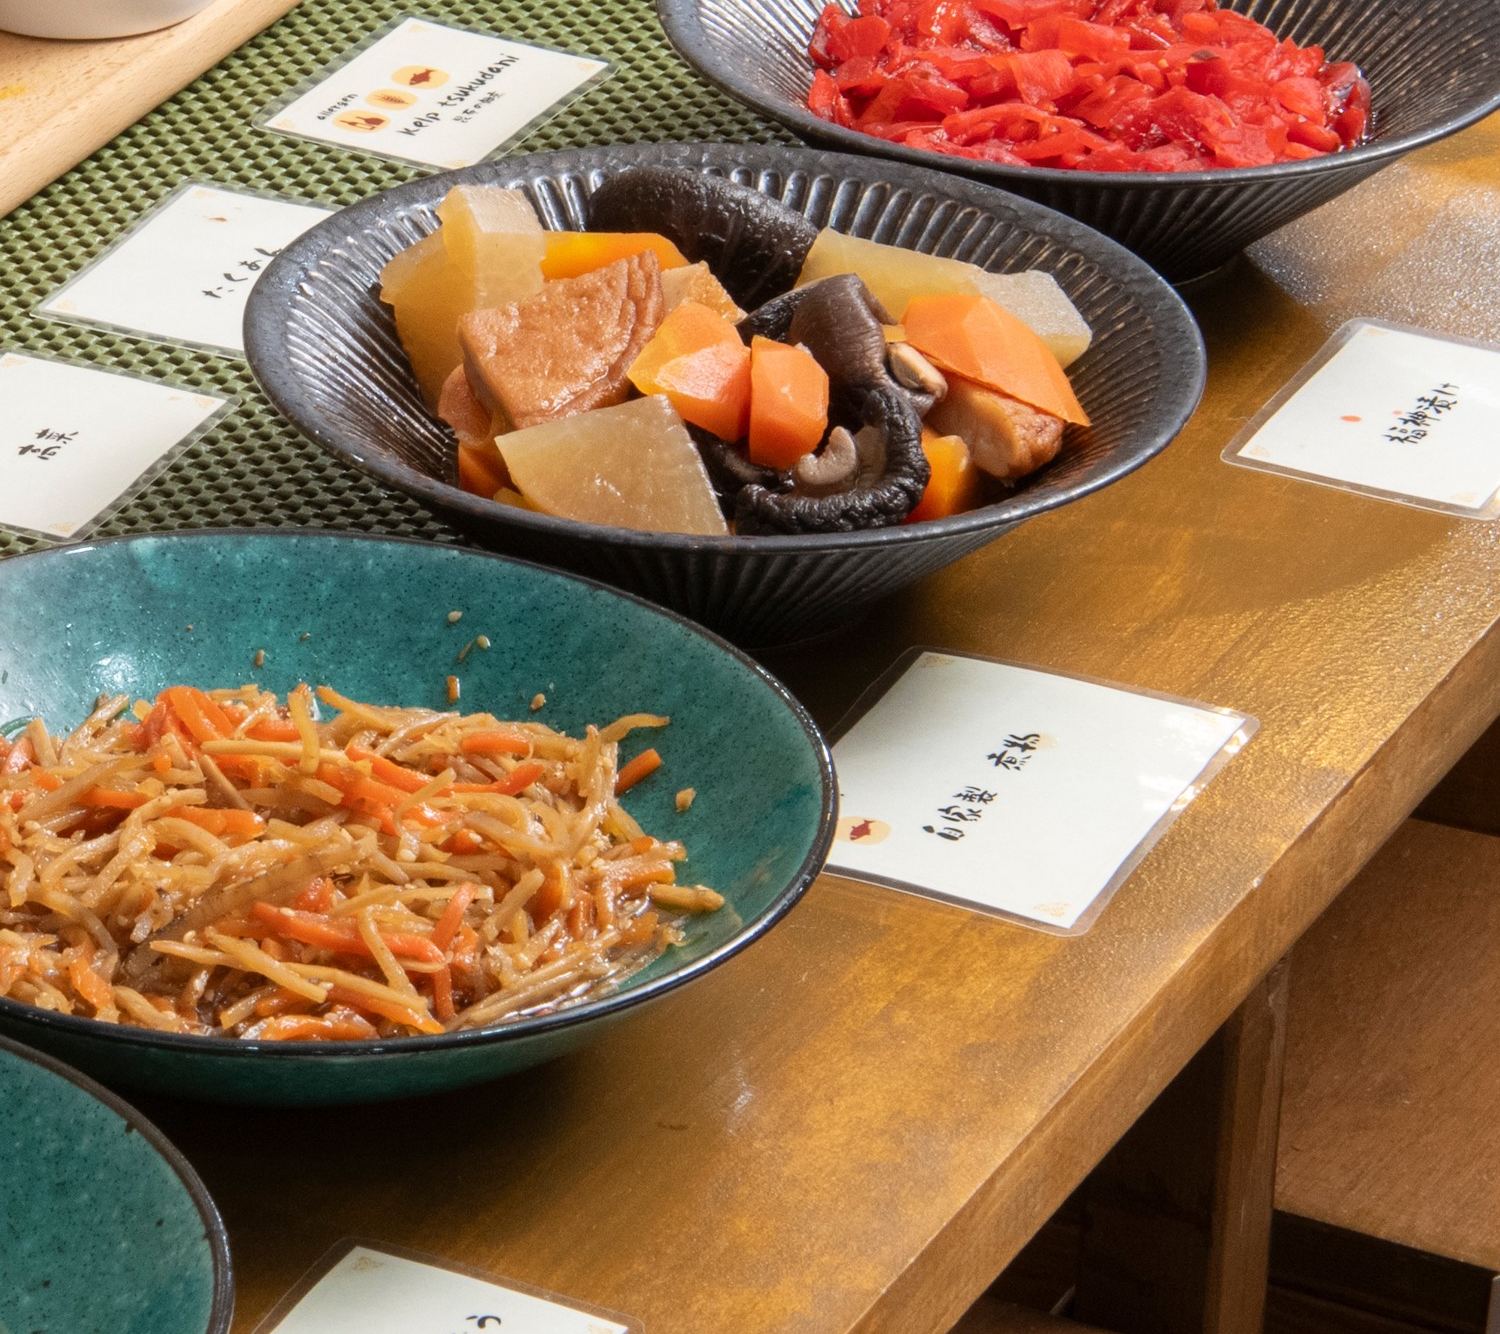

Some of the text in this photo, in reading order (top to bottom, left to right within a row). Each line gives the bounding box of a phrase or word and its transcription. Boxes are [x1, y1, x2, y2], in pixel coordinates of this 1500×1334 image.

[315, 93, 359, 121] allergen
[437, 52, 520, 109] tsukudani
[1382, 383, 1460, 444] 福神漬け
[17, 428, 79, 461] 高菜
[922, 732, 1041, 842] 自家製 煮物
